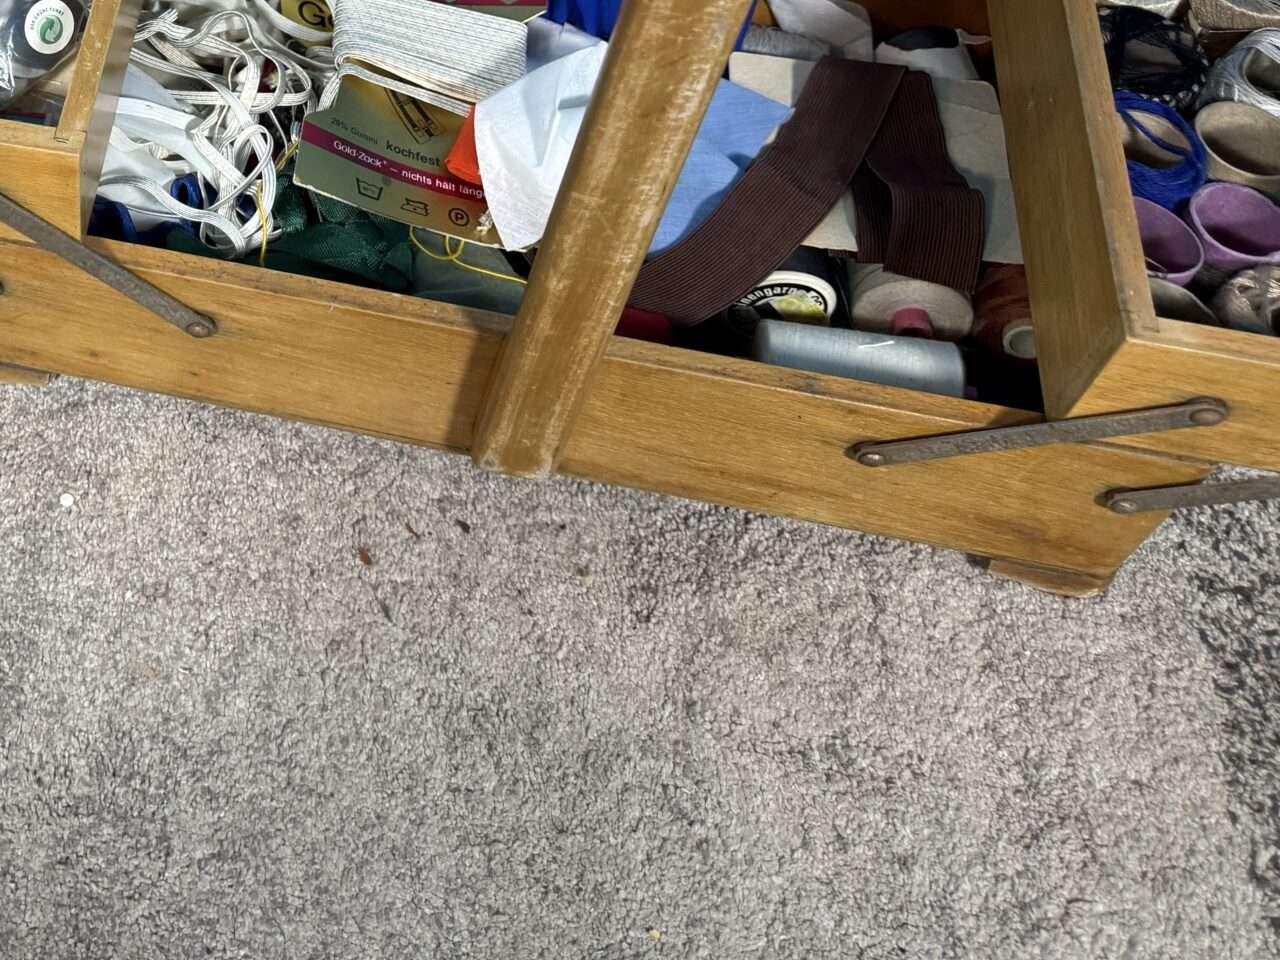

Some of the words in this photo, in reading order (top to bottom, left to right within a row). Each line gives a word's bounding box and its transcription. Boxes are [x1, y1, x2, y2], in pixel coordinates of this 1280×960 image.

[385, 140, 441, 168] kochfest
[401, 169, 433, 186] nichts
[459, 184, 485, 199] läng
